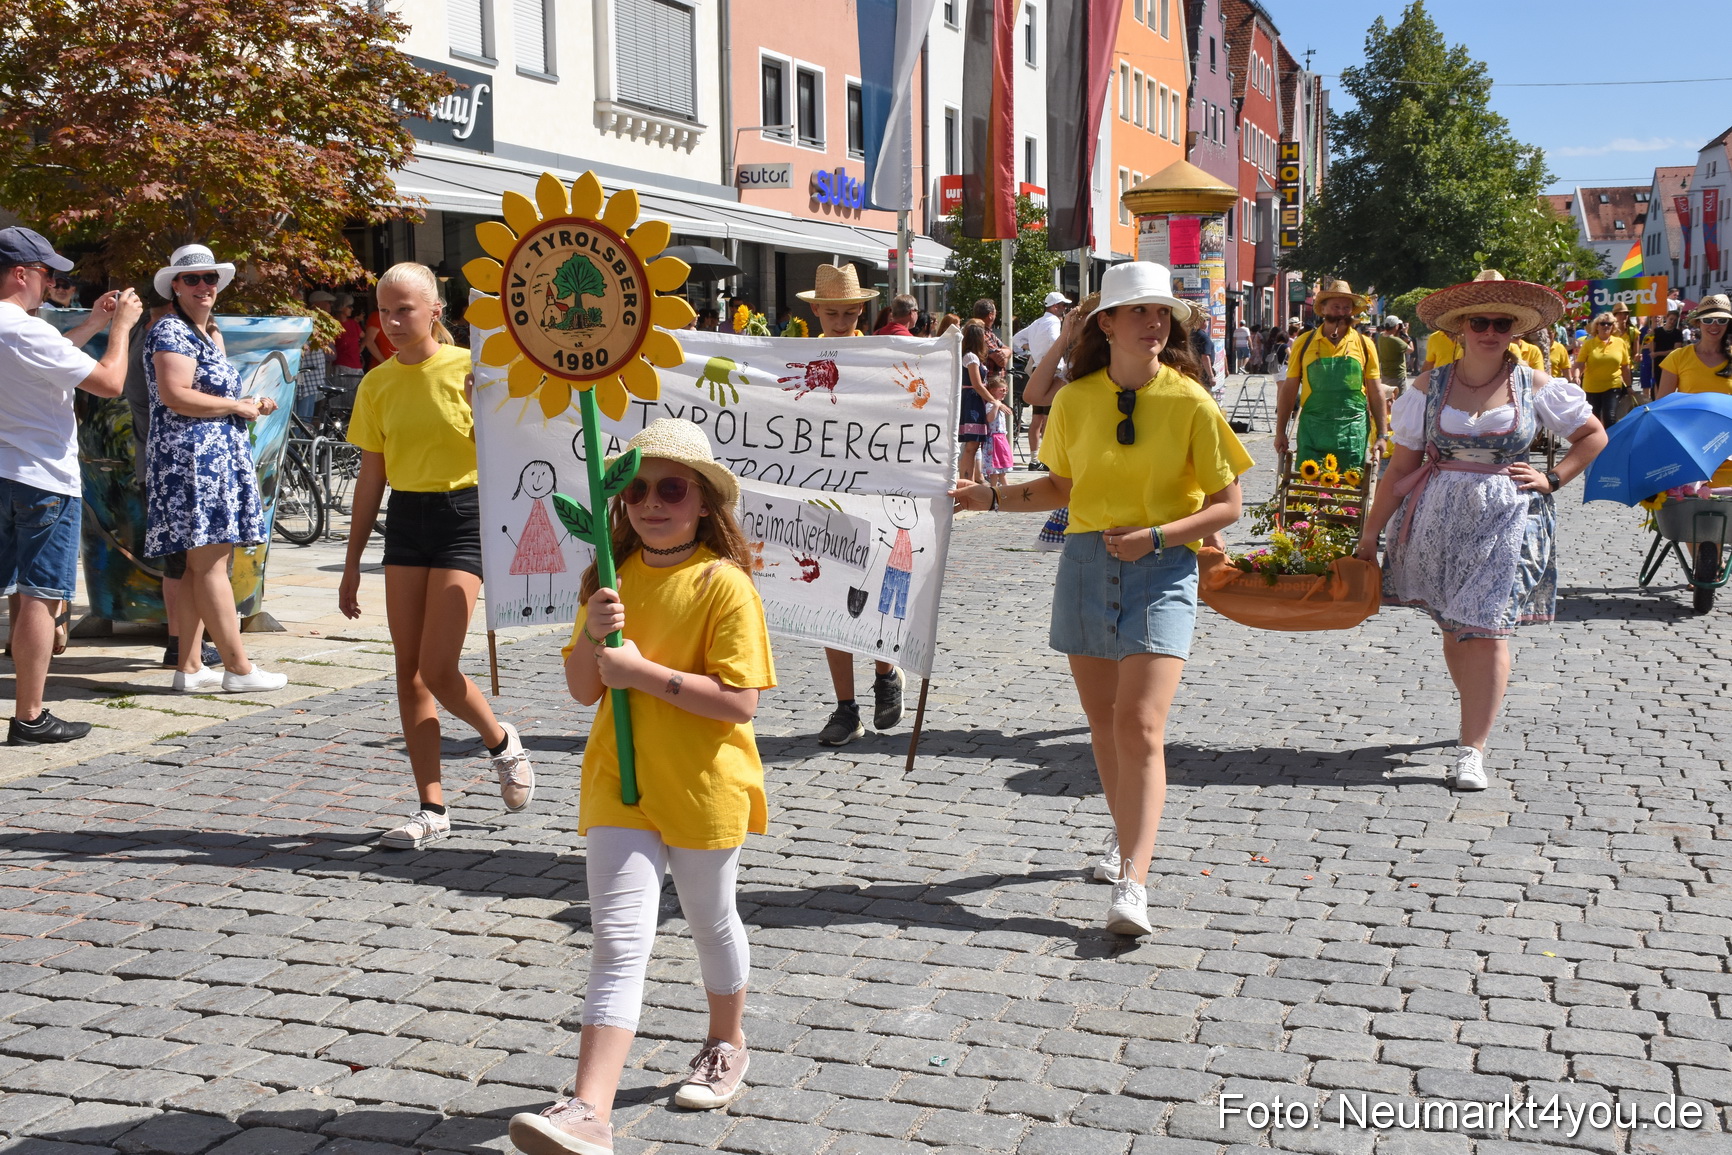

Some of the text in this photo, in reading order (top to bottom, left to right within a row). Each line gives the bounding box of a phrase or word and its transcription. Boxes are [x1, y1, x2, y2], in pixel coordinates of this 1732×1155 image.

[739, 167, 788, 184] sutor.
[1281, 144, 1299, 247] HOTEL
[511, 272, 529, 326] OGV
[529, 230, 637, 327] TYROLSBERG
[553, 348, 609, 371] 1980
[816, 350, 838, 358] JANA
[742, 494, 870, 569] heimatverbunden
